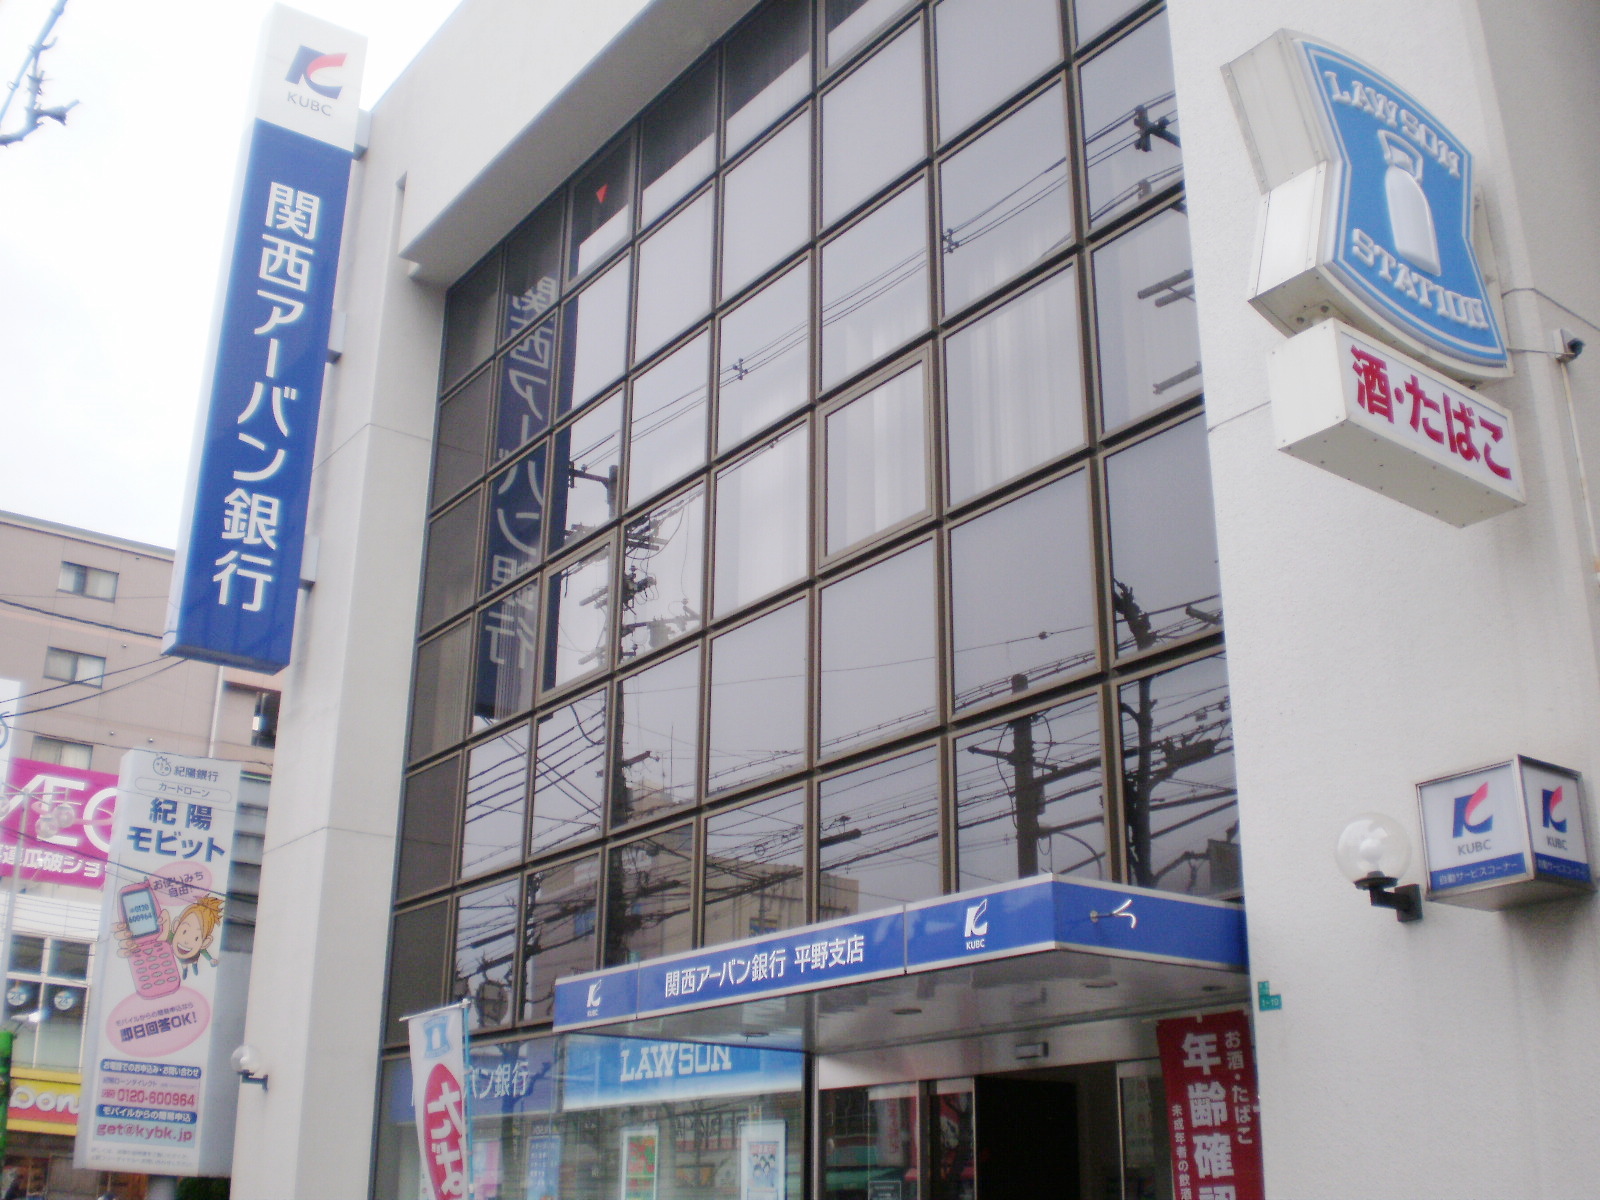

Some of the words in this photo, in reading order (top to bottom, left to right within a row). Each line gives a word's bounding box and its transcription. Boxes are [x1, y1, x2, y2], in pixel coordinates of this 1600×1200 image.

[288, 91, 332, 117] KUBC
[1325, 71, 1461, 179] LAWSON
[1352, 228, 1489, 330] STATION
[213, 181, 320, 612] 関西アーバン銀行
[1351, 344, 1512, 481] 酒・たばこ
[159, 782, 210, 798] カードローン
[173, 766, 219, 782] 紀陽銀行
[149, 797, 212, 831] 紀陽
[127, 825, 225, 862] モビット
[1457, 839, 1492, 856] KUBC
[1547, 835, 1568, 851] KUBC
[0, 844, 100, 878] 連瓜破ショ
[153, 871, 204, 891] お使いみち
[965, 938, 985, 951] KUBC
[665, 949, 786, 998] 関西アーバン銀行
[794, 934, 864, 973] 平野支店
[120, 1011, 198, 1043] 即日回答OK!
[587, 1008, 599, 1017] KUBC
[620, 1043, 732, 1083] LAWSON
[117, 1088, 195, 1107] 0120-600964
[1224, 1031, 1252, 1145] お酒・たばこ
[97, 1123, 192, 1142] get@kybk.jp
